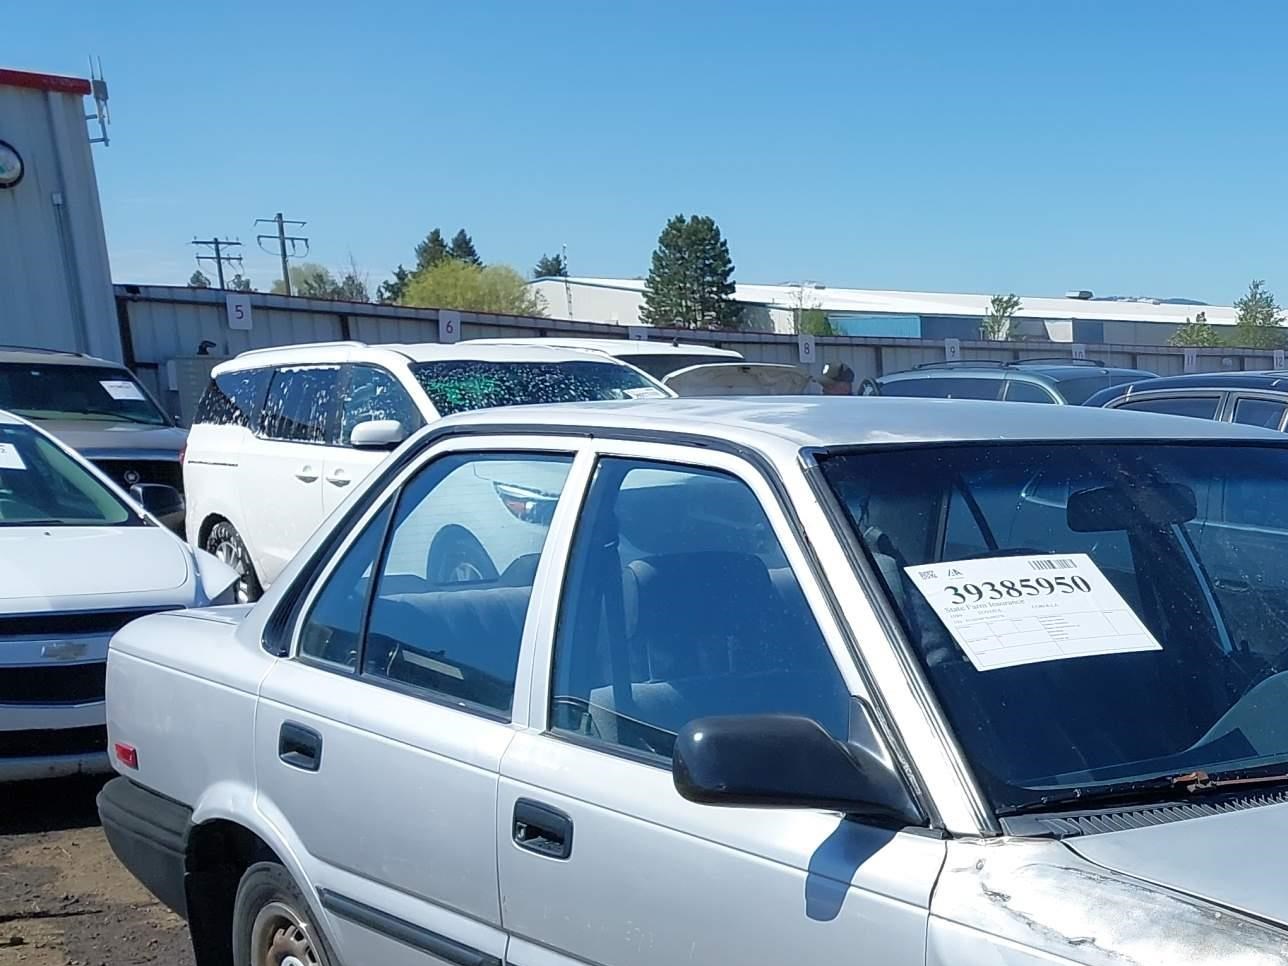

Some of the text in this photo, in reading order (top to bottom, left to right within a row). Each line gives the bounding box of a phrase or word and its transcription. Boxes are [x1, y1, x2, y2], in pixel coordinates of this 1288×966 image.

[235, 304, 244, 320] 5
[446, 320, 454, 334] 6
[803, 342, 810, 355] 8
[950, 345, 956, 358] 9
[943, 575, 1092, 605] 39385950
